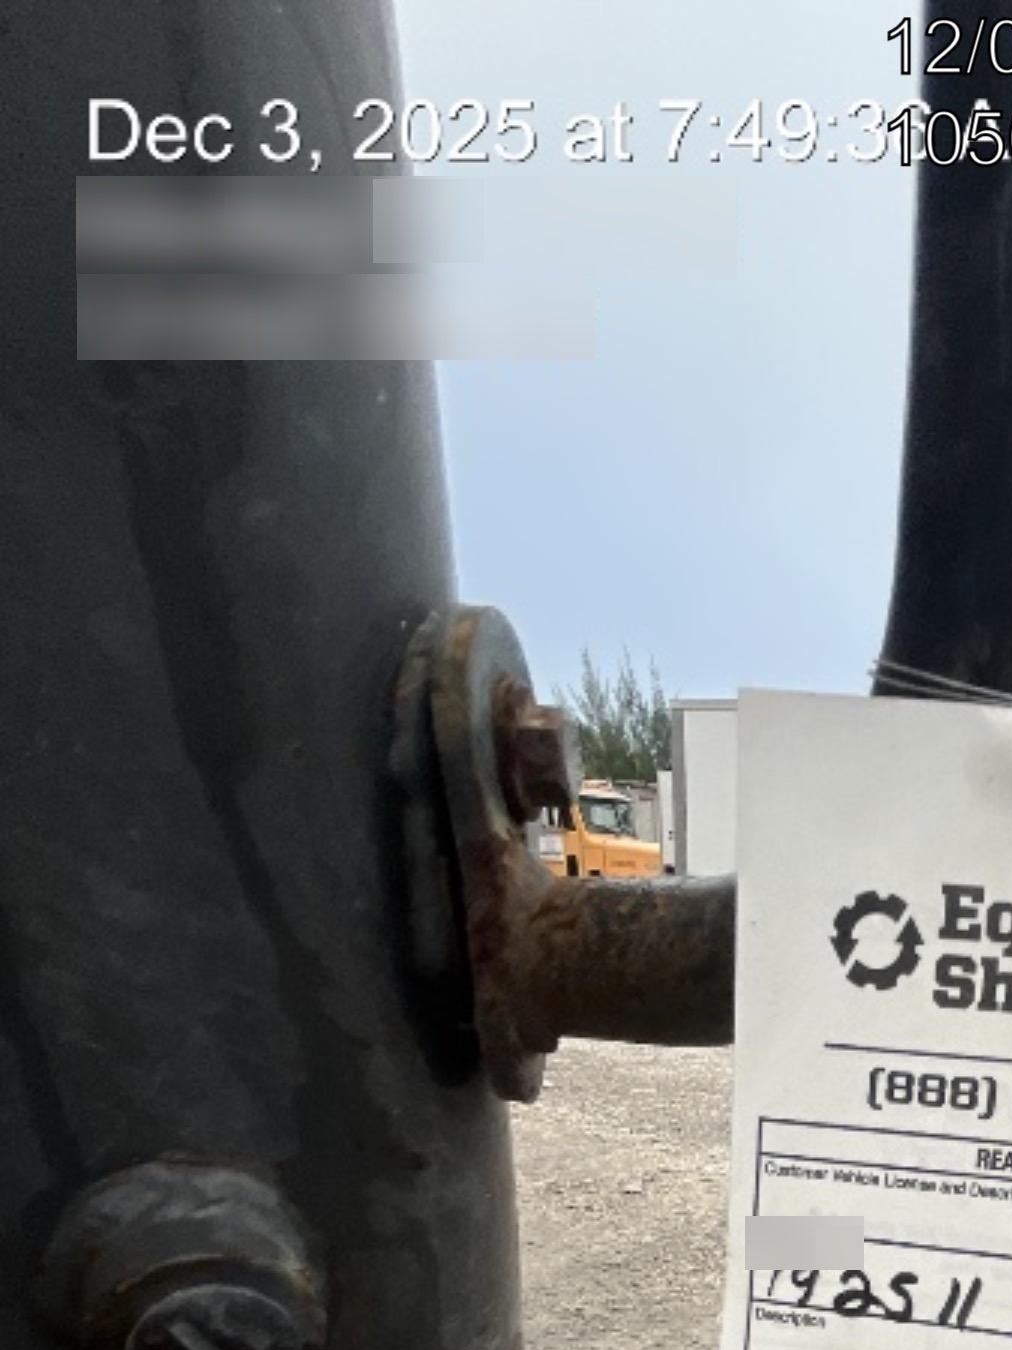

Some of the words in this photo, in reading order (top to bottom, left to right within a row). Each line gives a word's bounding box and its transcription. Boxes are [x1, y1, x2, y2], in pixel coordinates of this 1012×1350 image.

[868, 1068, 999, 1121] (888)
[763, 1160, 829, 1182] Customer
[833, 1168, 881, 1187] Vehicle
[884, 1174, 937, 1194] License
[938, 1181, 968, 1196] and
[755, 1307, 827, 1330] Description
